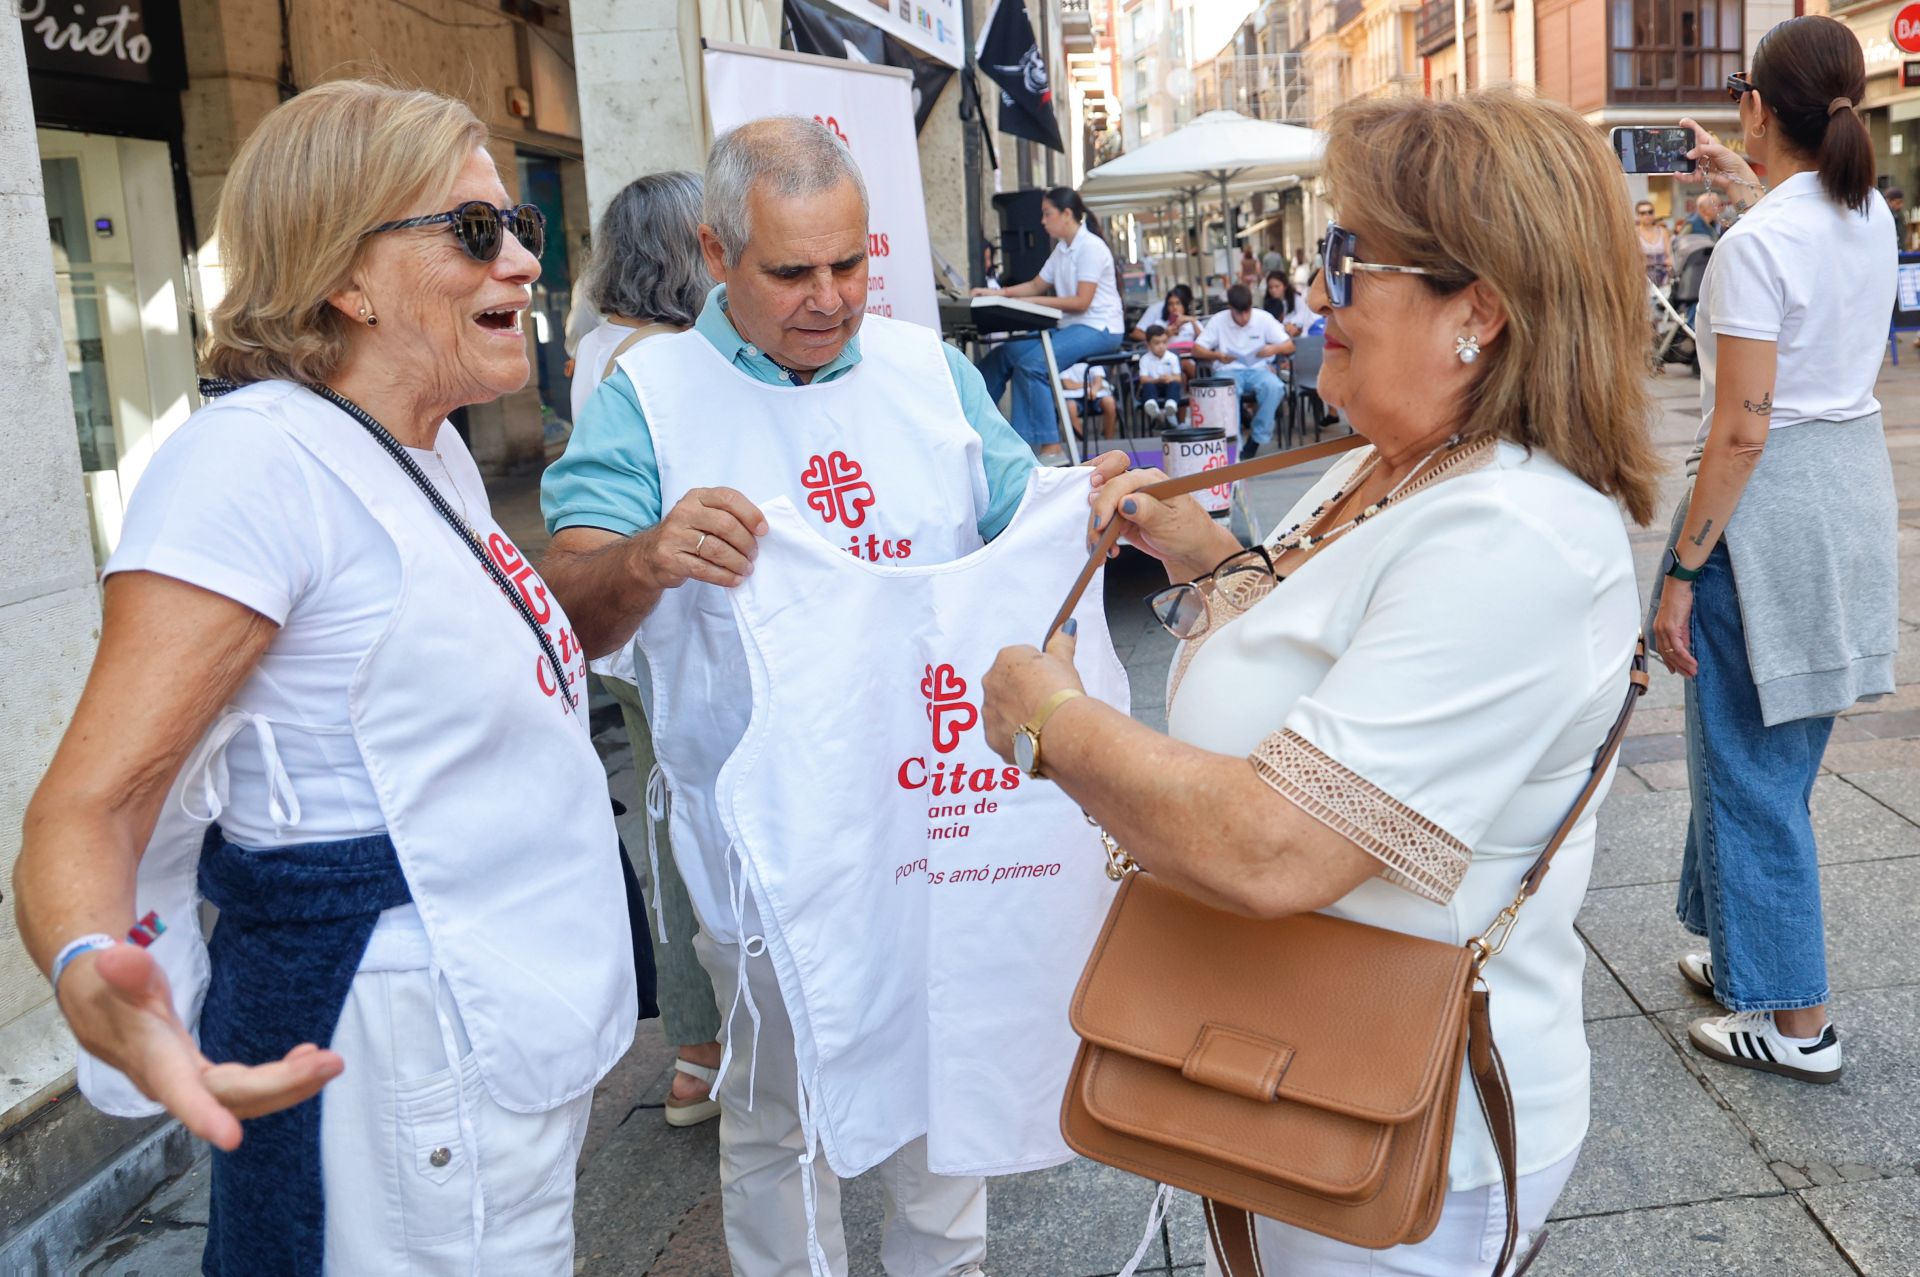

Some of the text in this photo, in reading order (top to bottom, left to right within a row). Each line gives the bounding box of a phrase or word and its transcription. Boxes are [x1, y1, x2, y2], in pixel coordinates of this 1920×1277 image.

[841, 534, 912, 562] itas
[974, 797, 998, 814] de
[949, 865, 990, 884] amó
[991, 862, 1061, 884] primero
